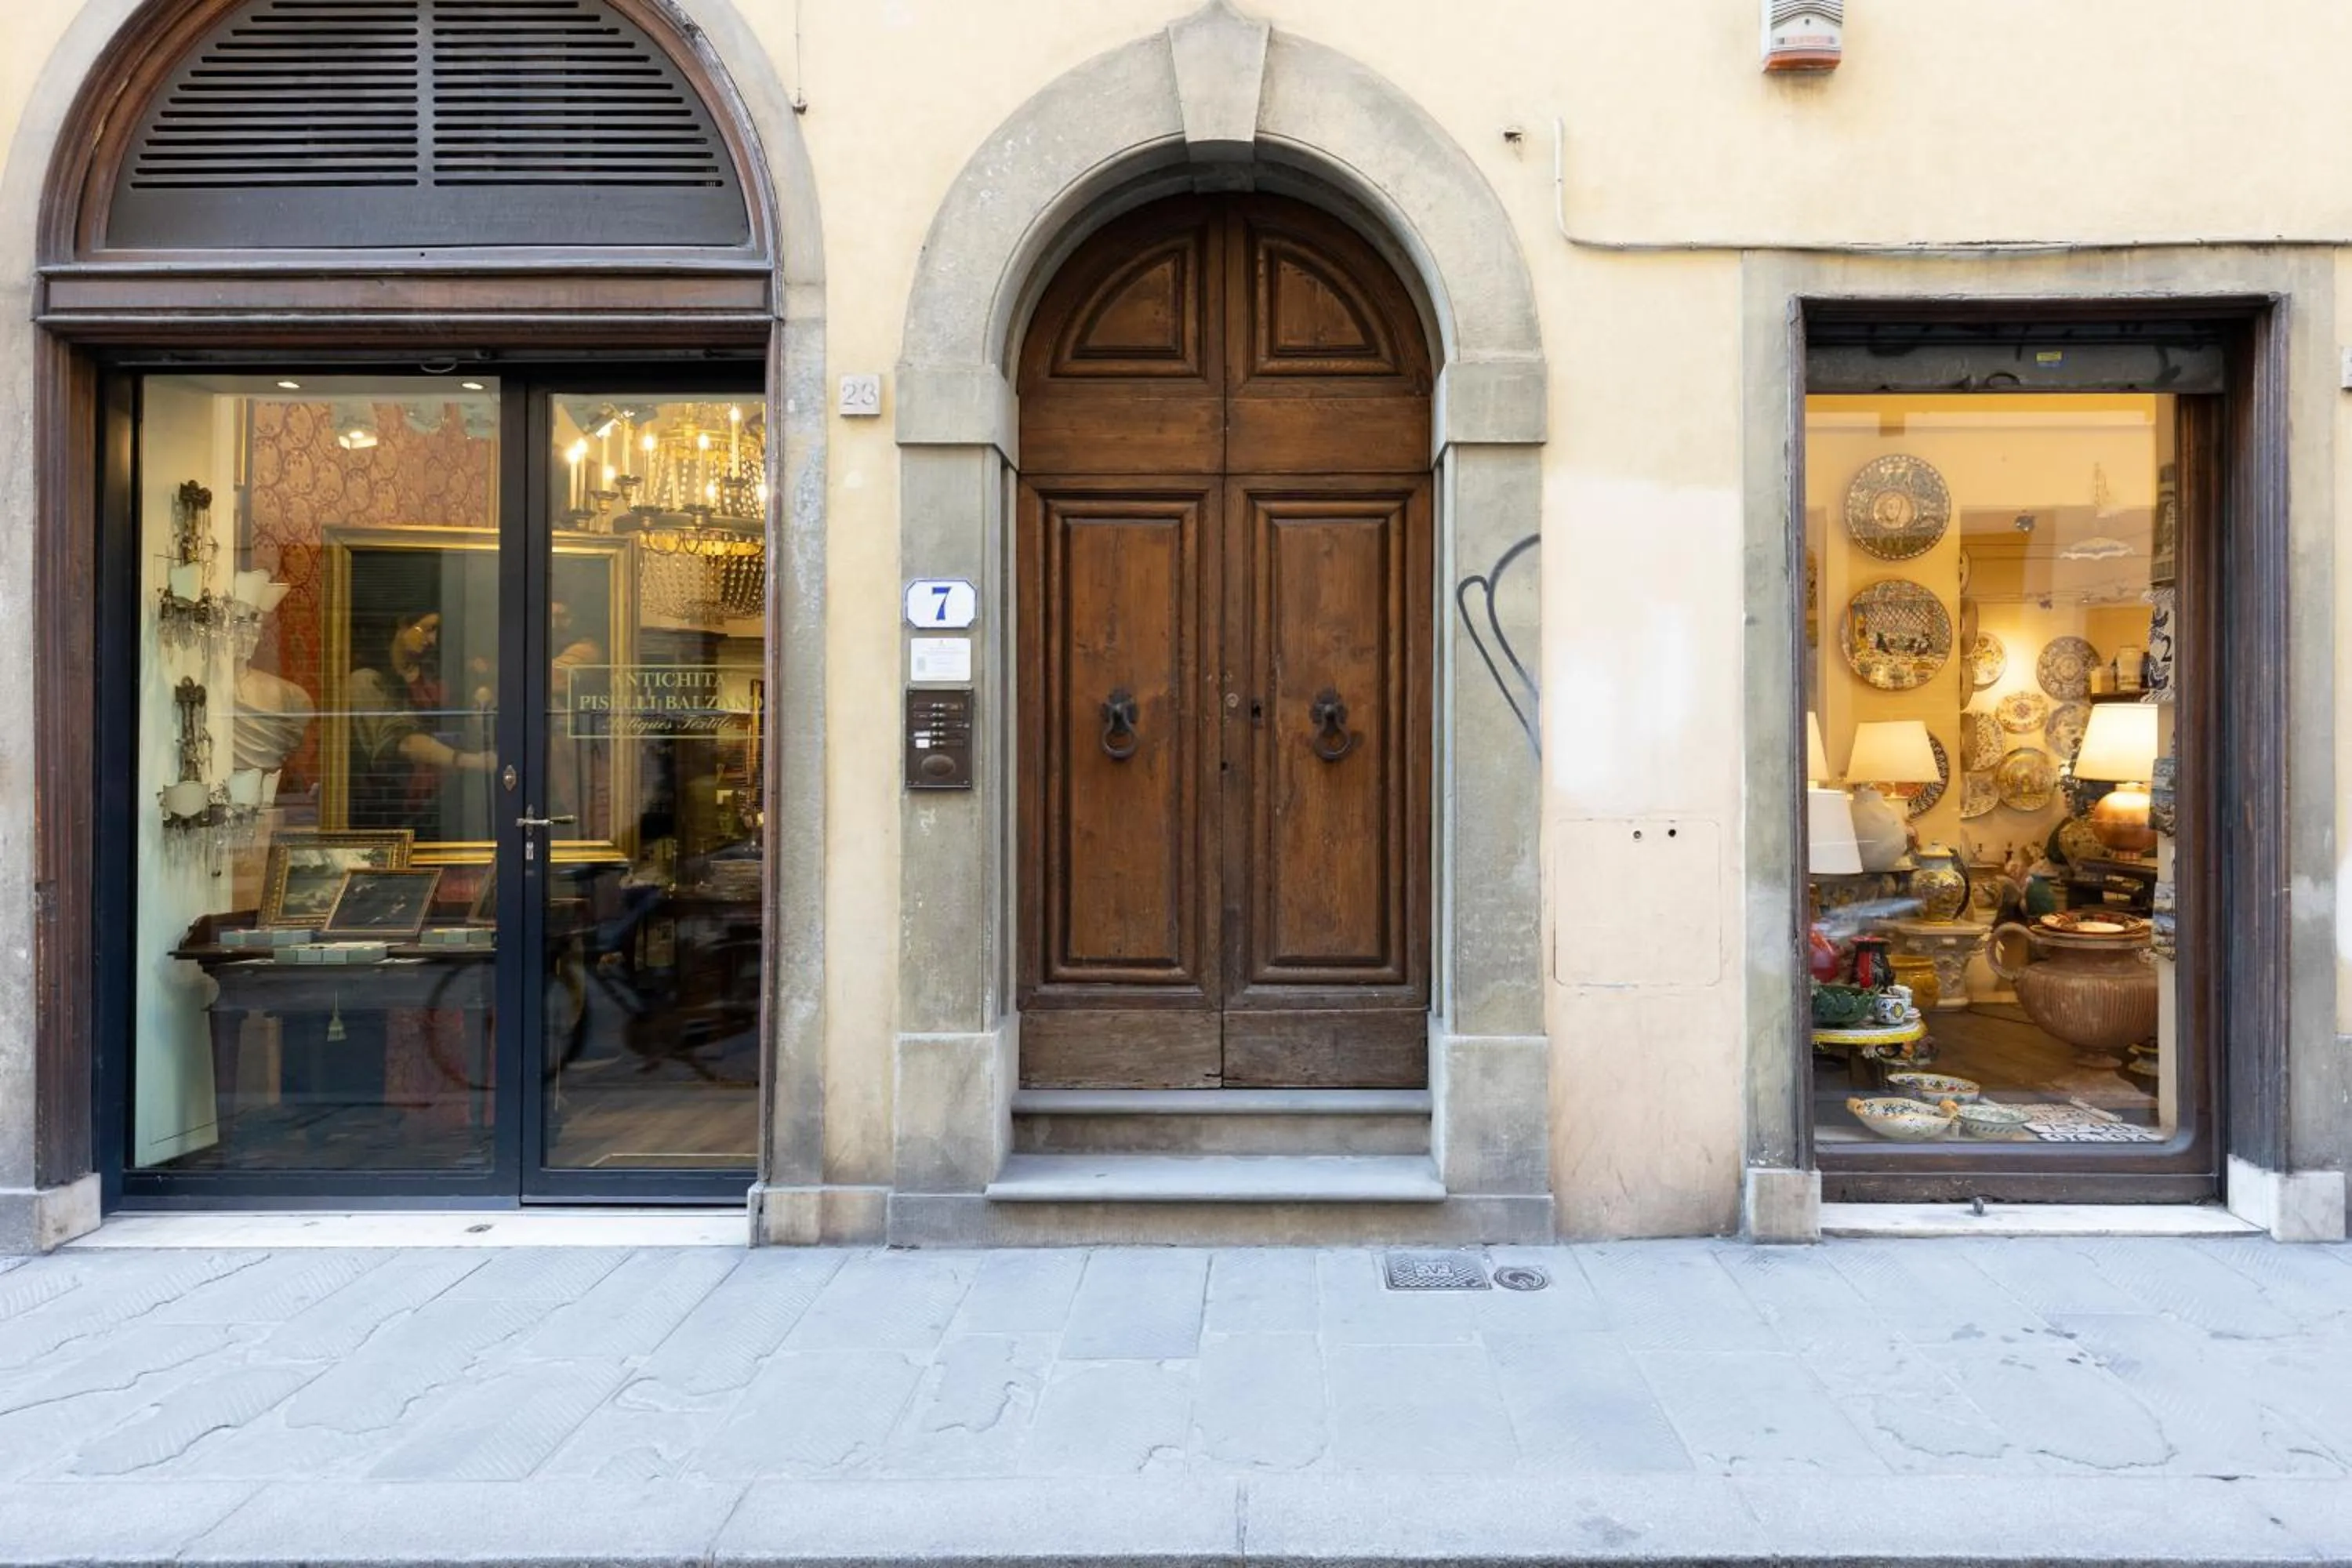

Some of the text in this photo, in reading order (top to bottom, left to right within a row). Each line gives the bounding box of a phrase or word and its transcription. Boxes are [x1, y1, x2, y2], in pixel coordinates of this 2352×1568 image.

[931, 586, 952, 620] 7
[2161, 635, 2172, 662] 2
[601, 715, 673, 735] tiques
